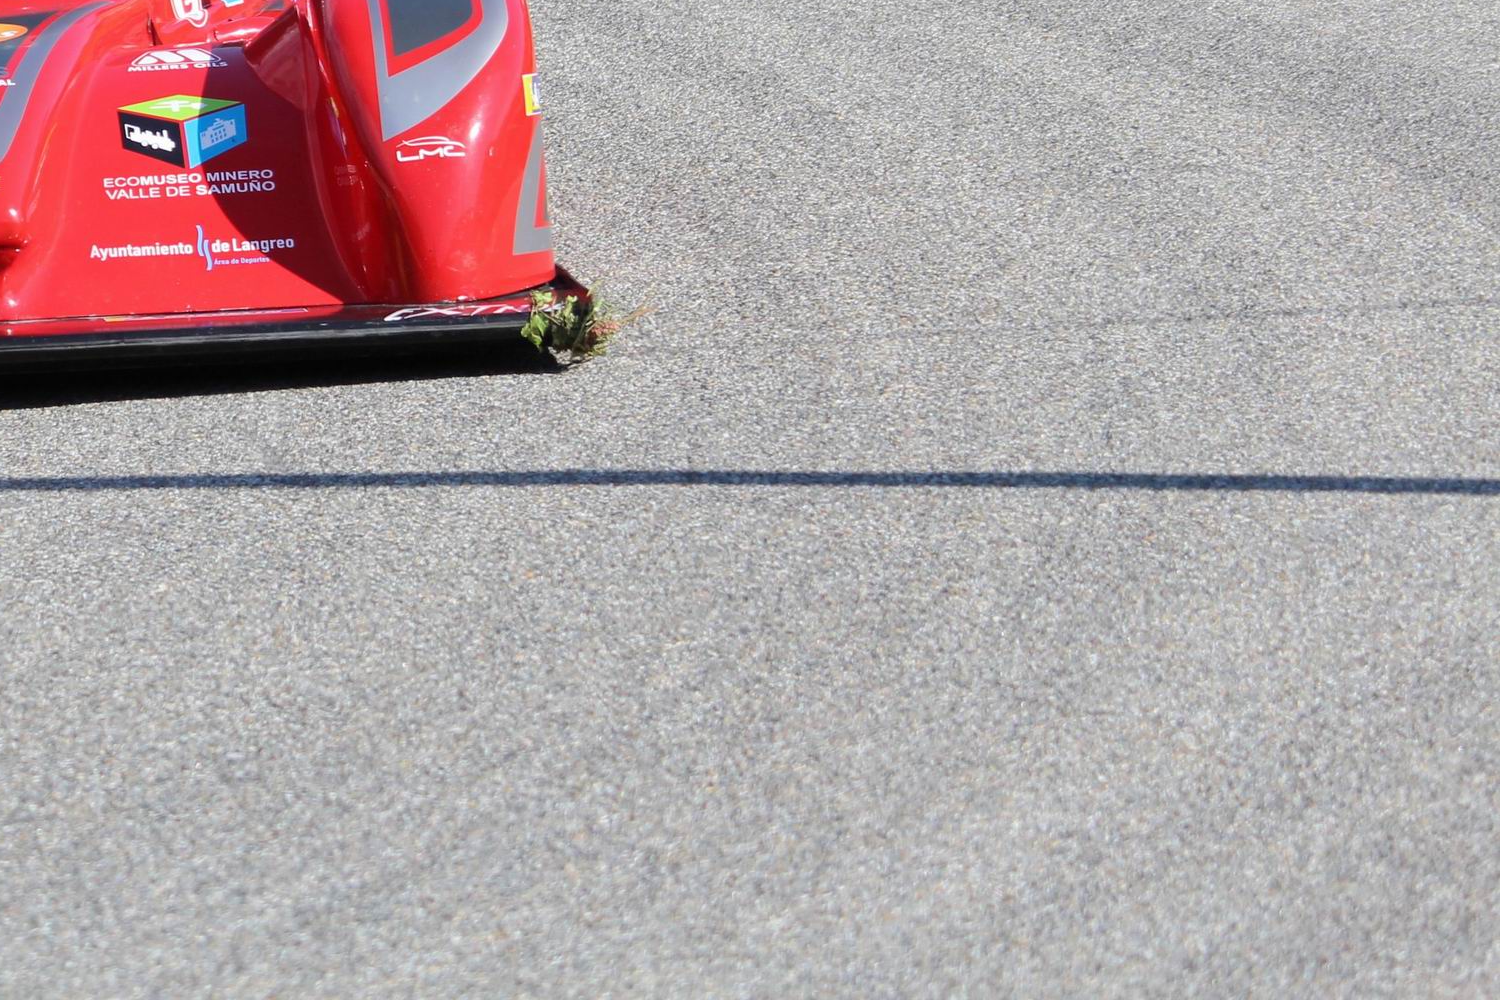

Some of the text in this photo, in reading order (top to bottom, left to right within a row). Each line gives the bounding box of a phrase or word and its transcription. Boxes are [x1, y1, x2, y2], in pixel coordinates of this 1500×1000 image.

[127, 61, 229, 72] MILLERS OILS
[102, 168, 274, 188] ECOMUSEO MINERO
[105, 180, 276, 200] VALLE DE SAMUÑO
[90, 237, 295, 262] Ayuntamiento de Langreo
[230, 256, 240, 265] de
[240, 255, 270, 266] Deportes
